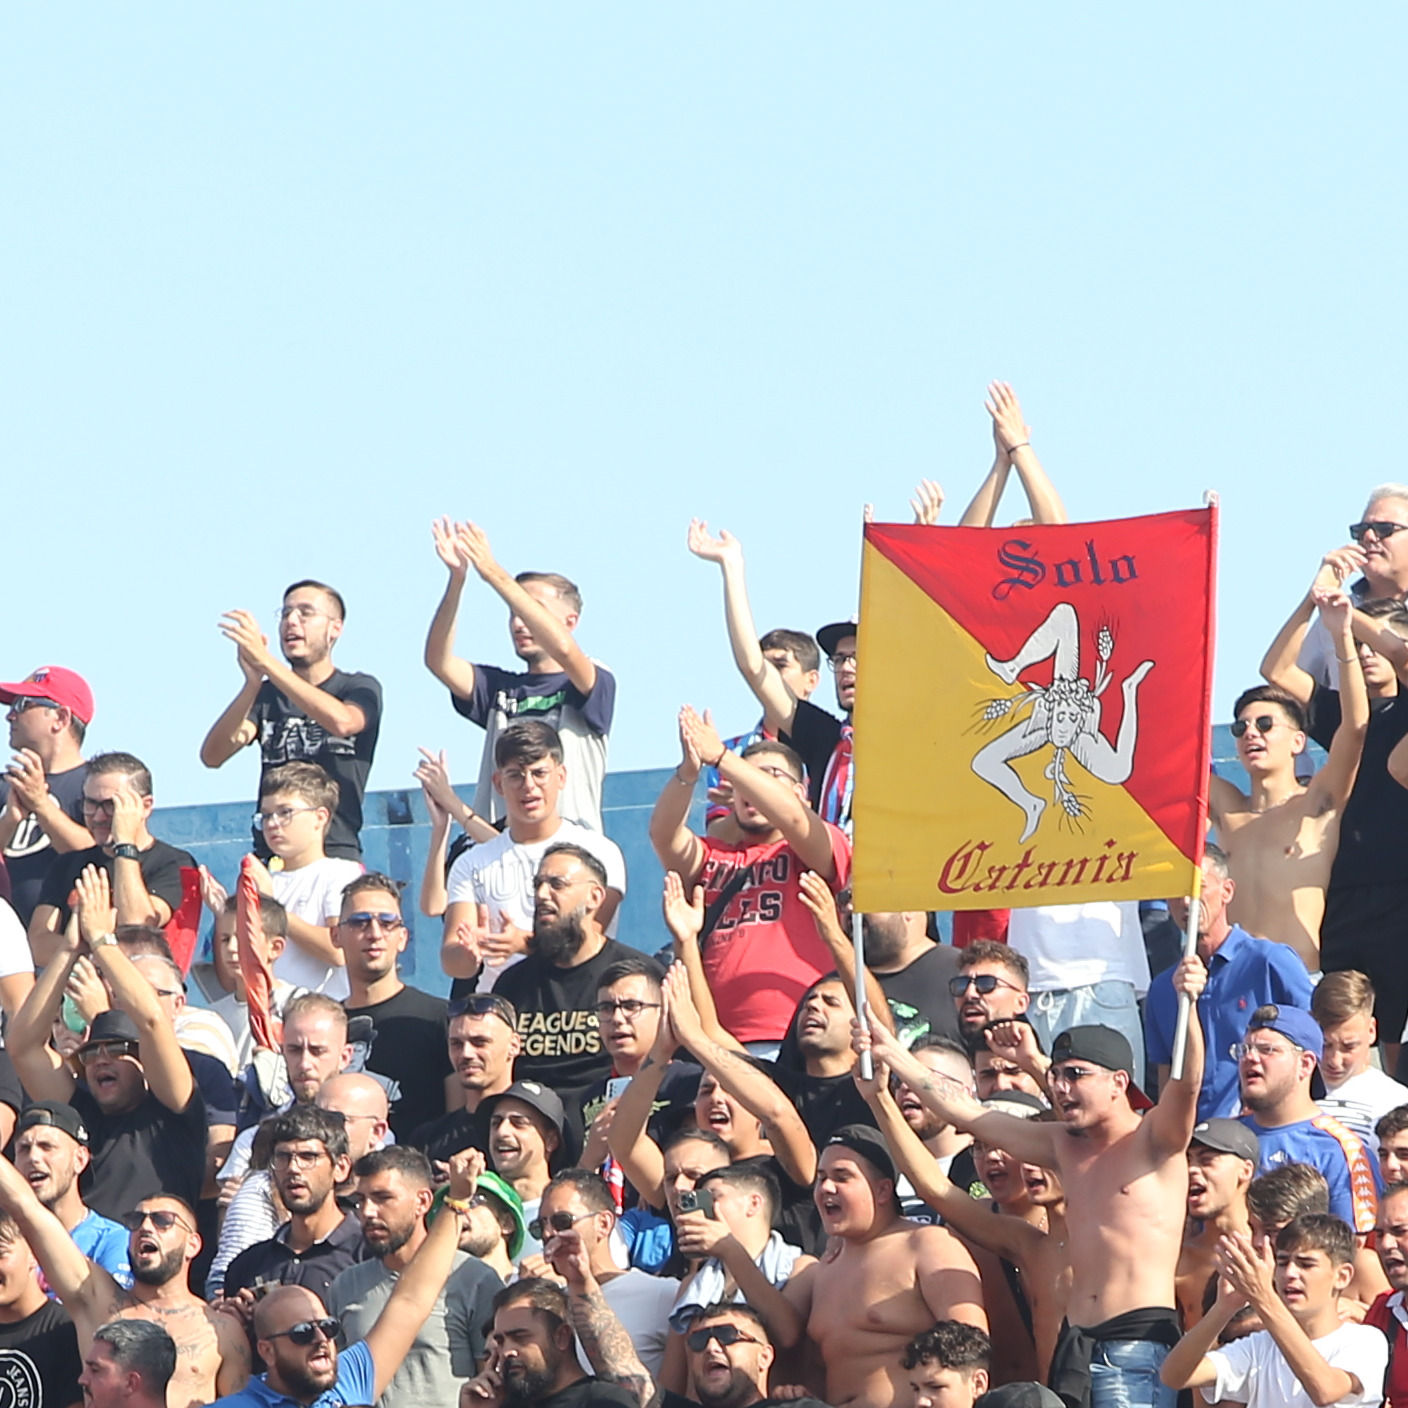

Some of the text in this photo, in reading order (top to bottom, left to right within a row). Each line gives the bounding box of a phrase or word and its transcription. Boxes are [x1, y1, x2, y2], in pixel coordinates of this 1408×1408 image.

[992, 538, 1140, 600] Solo
[937, 838, 1138, 896] Catania
[517, 1010, 588, 1033] EAGUE
[519, 1030, 601, 1056] EGENDS
[6, 1366, 29, 1408] JEANS
